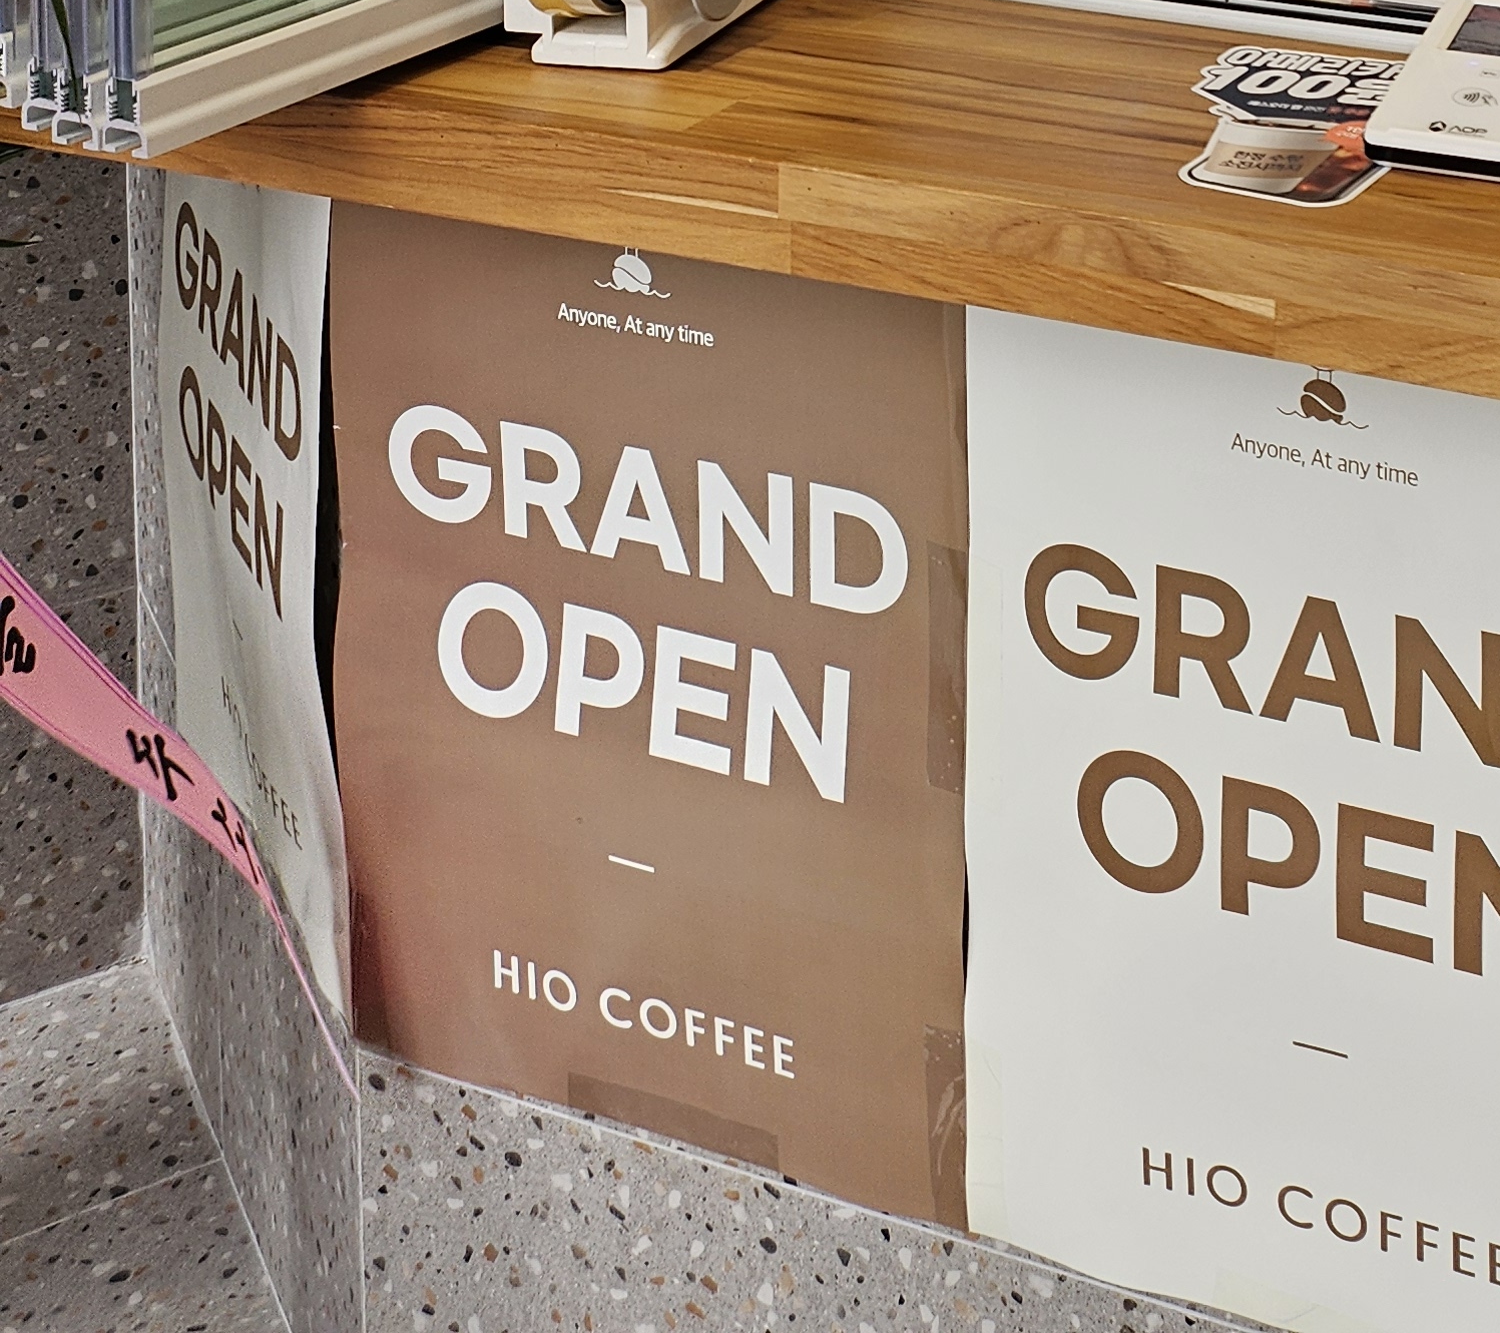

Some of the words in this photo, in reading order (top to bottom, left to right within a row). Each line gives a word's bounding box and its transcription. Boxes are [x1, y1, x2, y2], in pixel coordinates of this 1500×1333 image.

[175, 202, 301, 461] GRAND
[559, 301, 620, 332] Anyone,
[625, 313, 642, 336] At
[646, 320, 674, 344] any
[678, 324, 715, 348] time
[179, 365, 283, 621] OPEN
[388, 405, 908, 614] GRAND
[438, 582, 851, 803] OPEN
[492, 949, 576, 1013] HIO
[600, 987, 796, 1080] COFFEE
[1141, 1146, 1249, 1208] HIO
